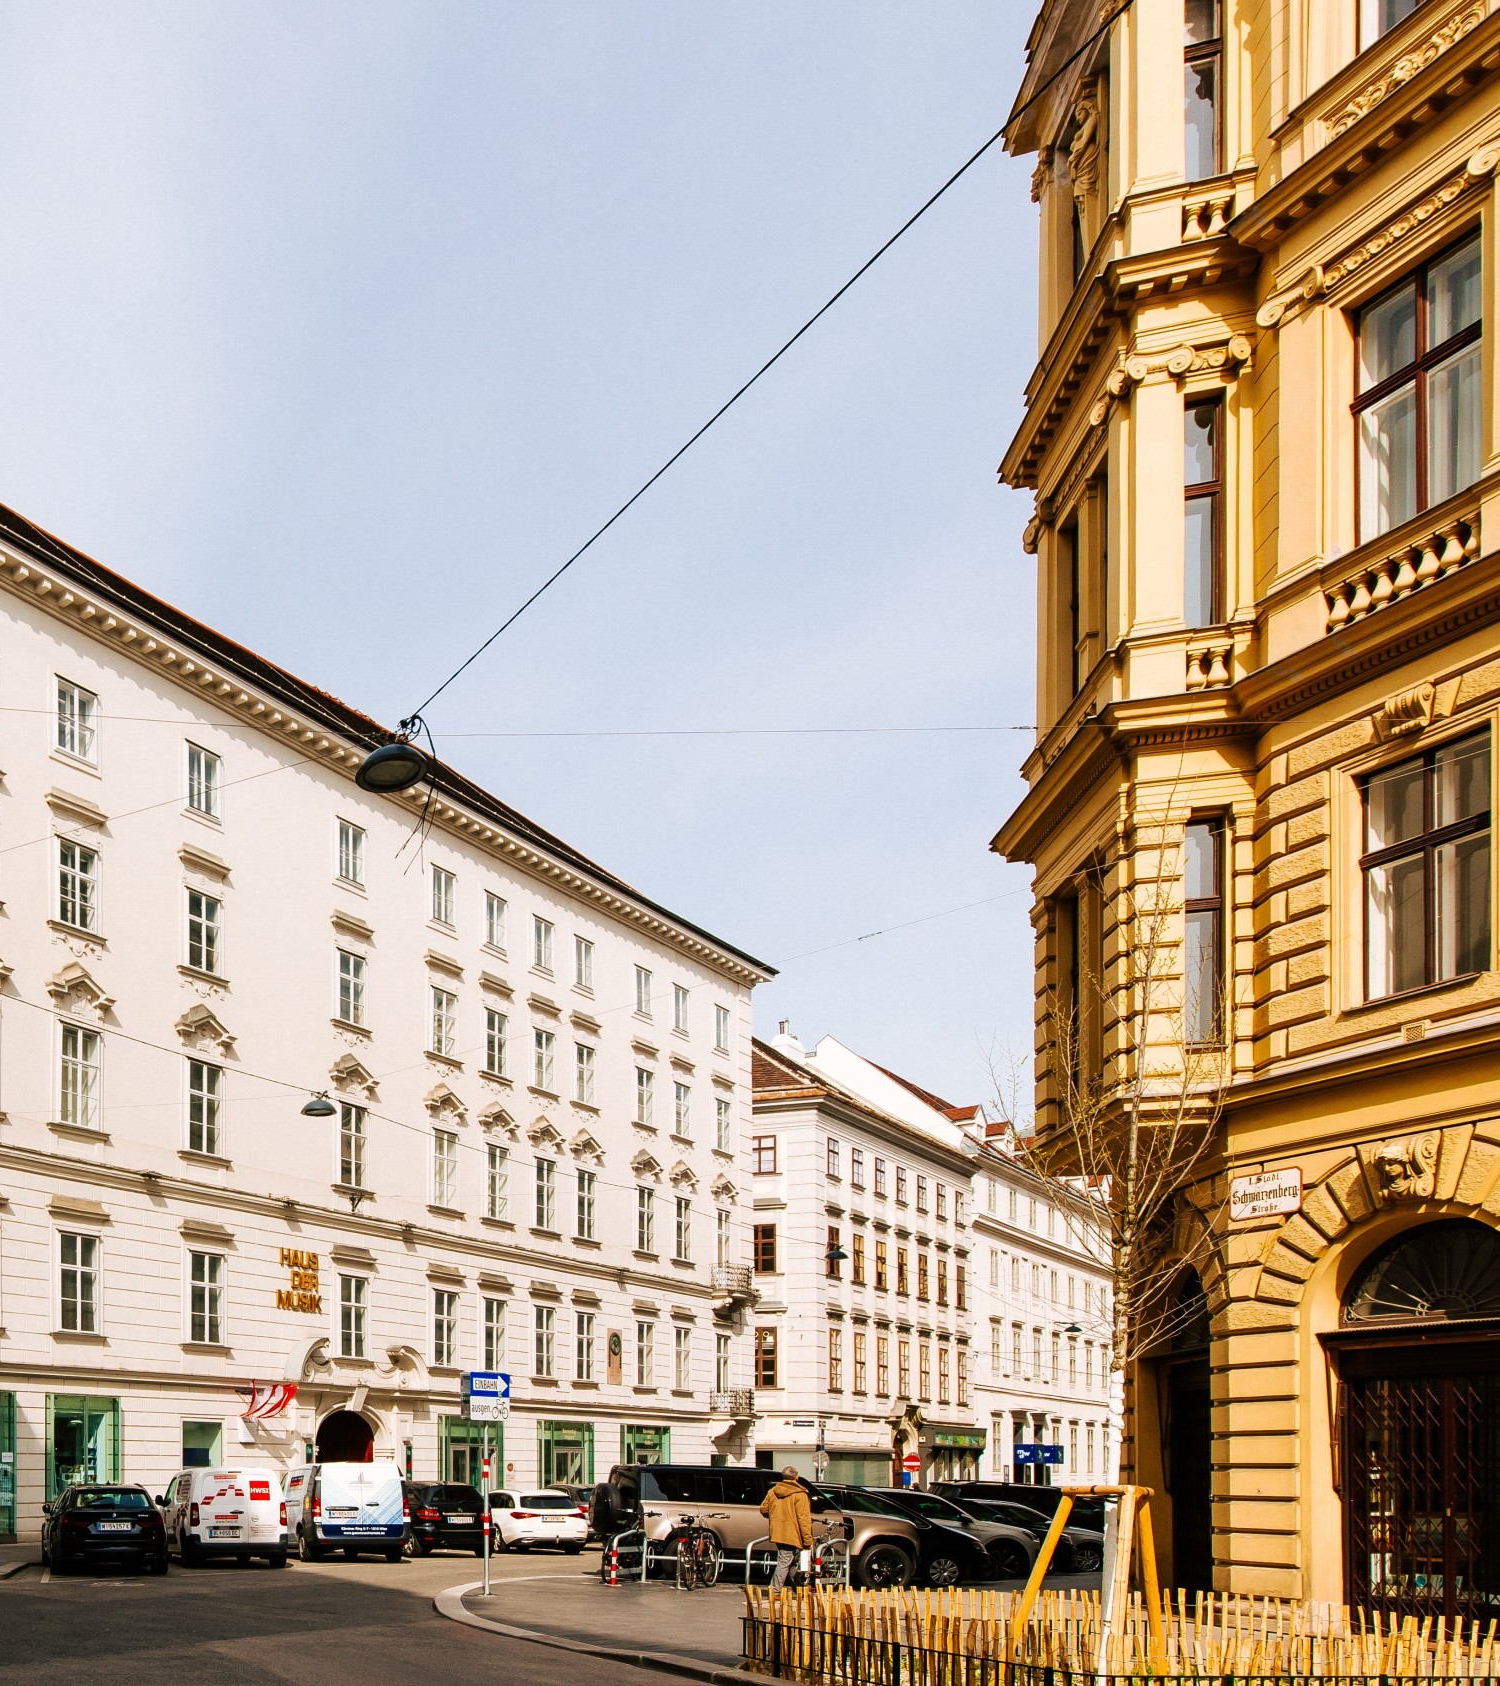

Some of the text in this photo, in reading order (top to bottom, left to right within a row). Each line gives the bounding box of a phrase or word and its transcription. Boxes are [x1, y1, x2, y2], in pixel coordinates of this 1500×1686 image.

[279, 1247, 319, 1271] HAUS
[290, 1269, 319, 1292] DER
[275, 1289, 323, 1315] MUSIK
[474, 1379, 498, 1390] EINBAHN
